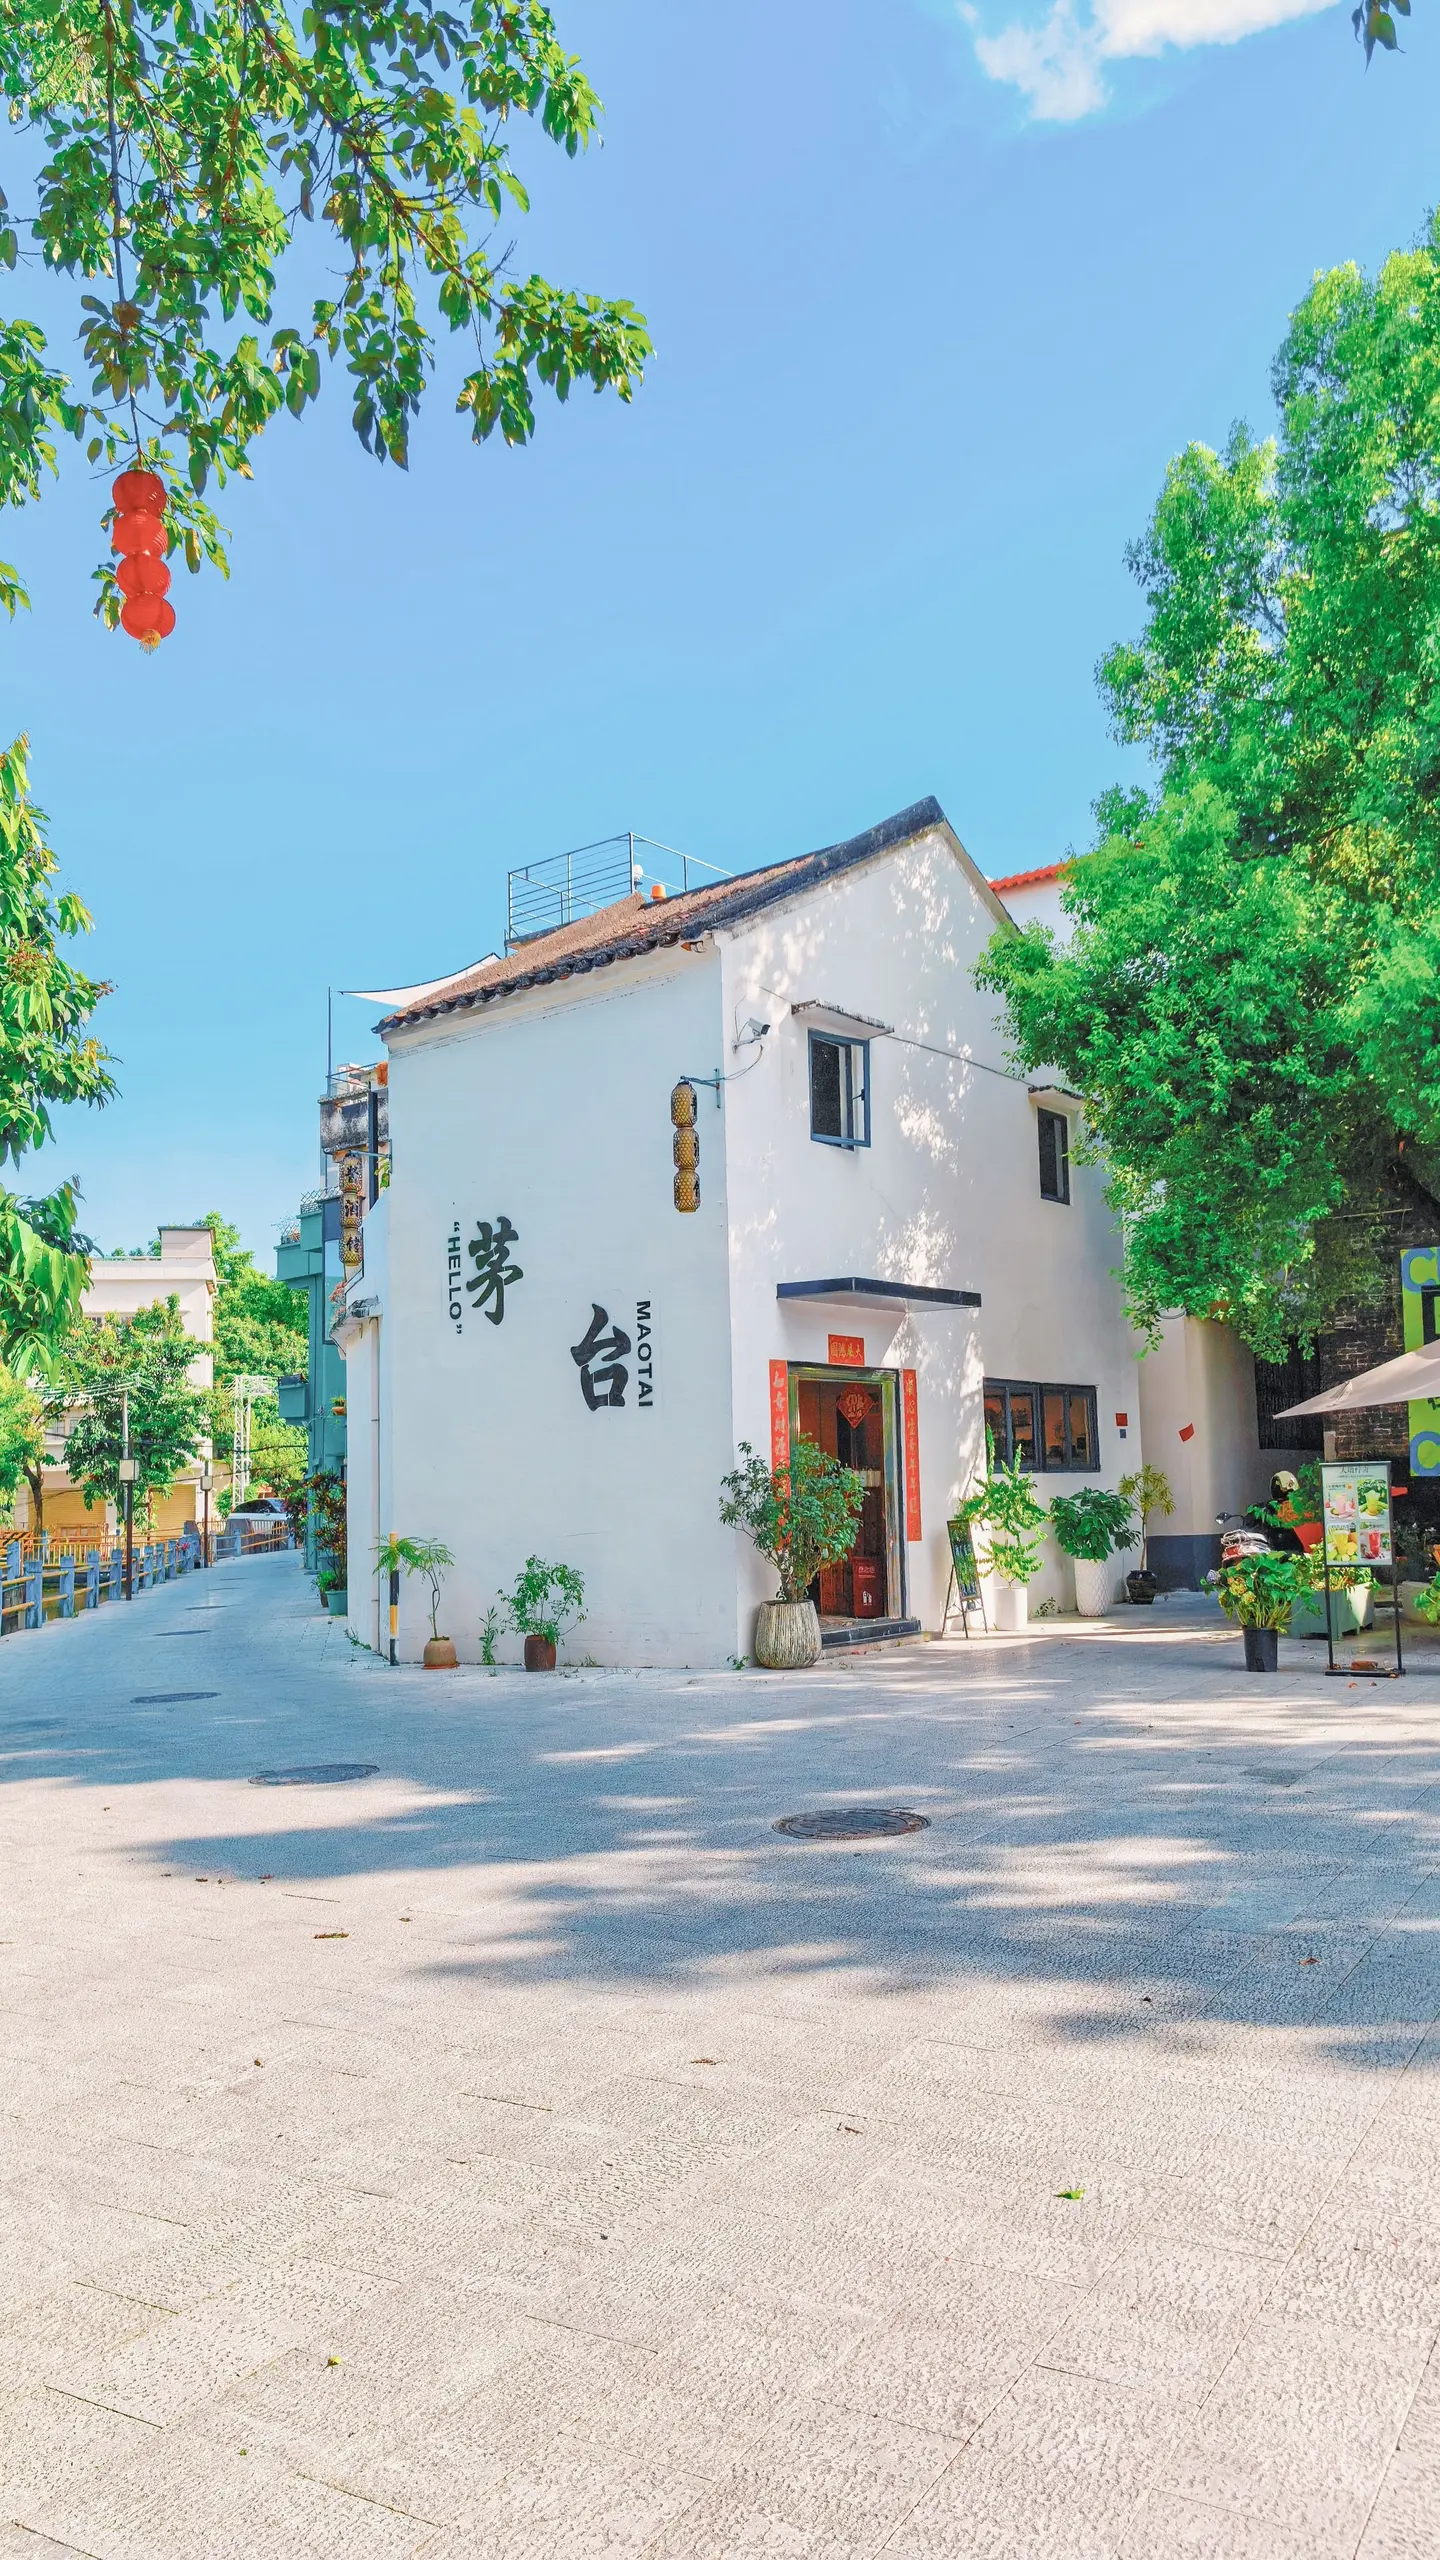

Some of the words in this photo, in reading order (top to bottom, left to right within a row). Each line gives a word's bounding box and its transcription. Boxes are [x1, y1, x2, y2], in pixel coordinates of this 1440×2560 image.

[466, 1216, 524, 1326] 茅
[570, 1303, 632, 1412] 台
[636, 1301, 653, 1407] MAOTAI
